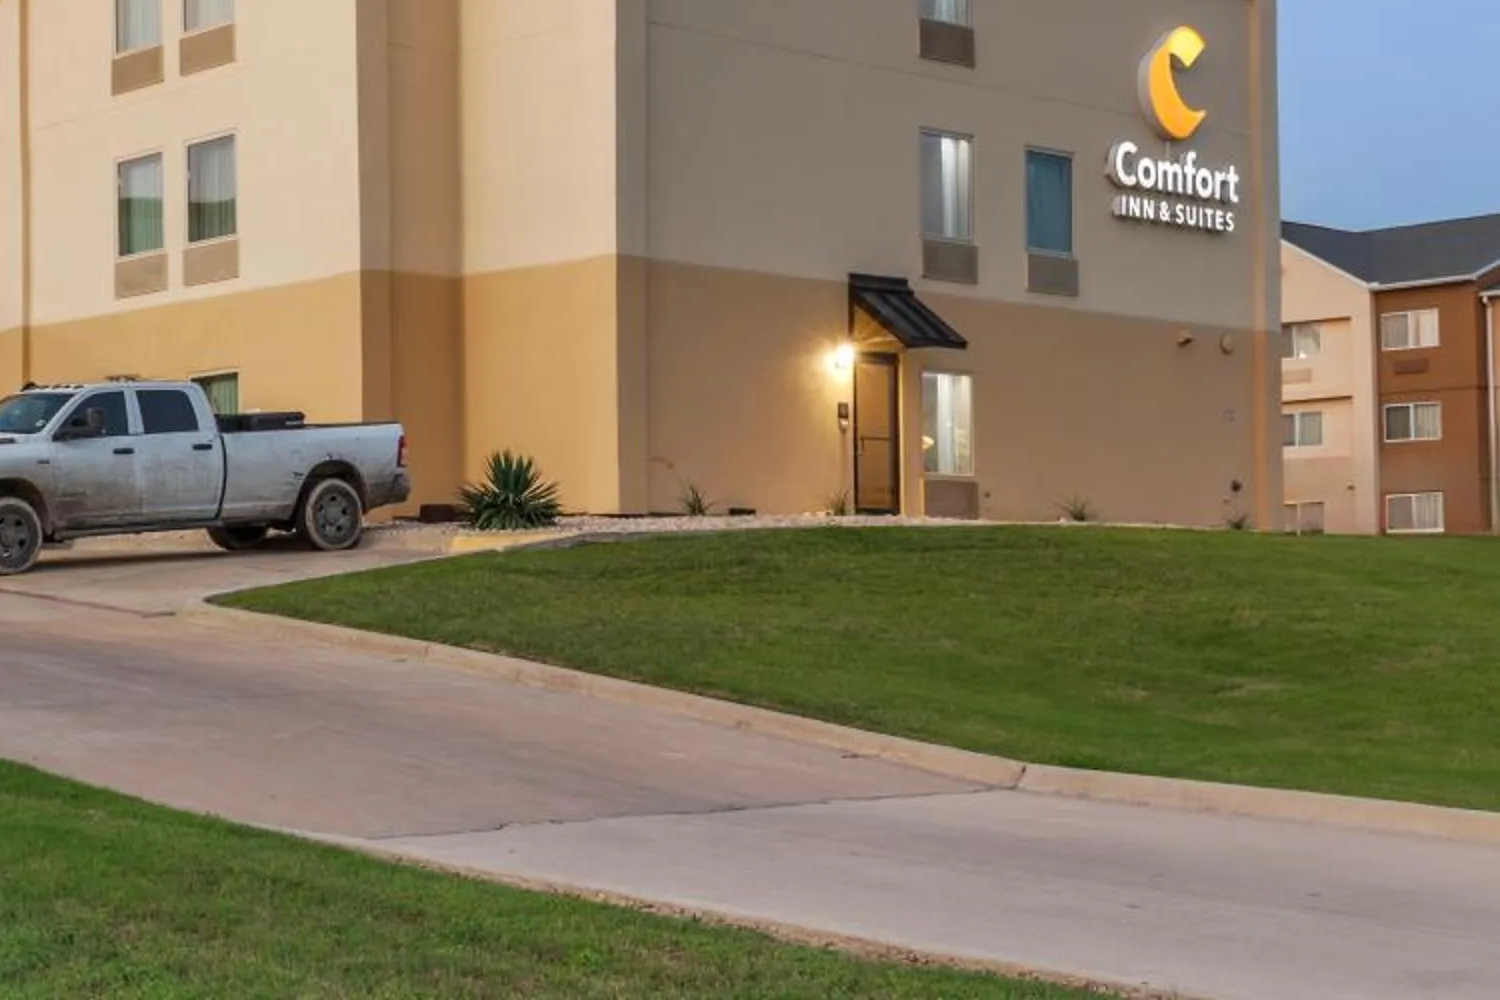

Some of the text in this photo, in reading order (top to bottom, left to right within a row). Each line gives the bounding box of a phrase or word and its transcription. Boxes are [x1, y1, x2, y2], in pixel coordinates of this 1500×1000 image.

[1115, 141, 1240, 203] Comfort
[1120, 195, 1235, 232] INN & SUITES
